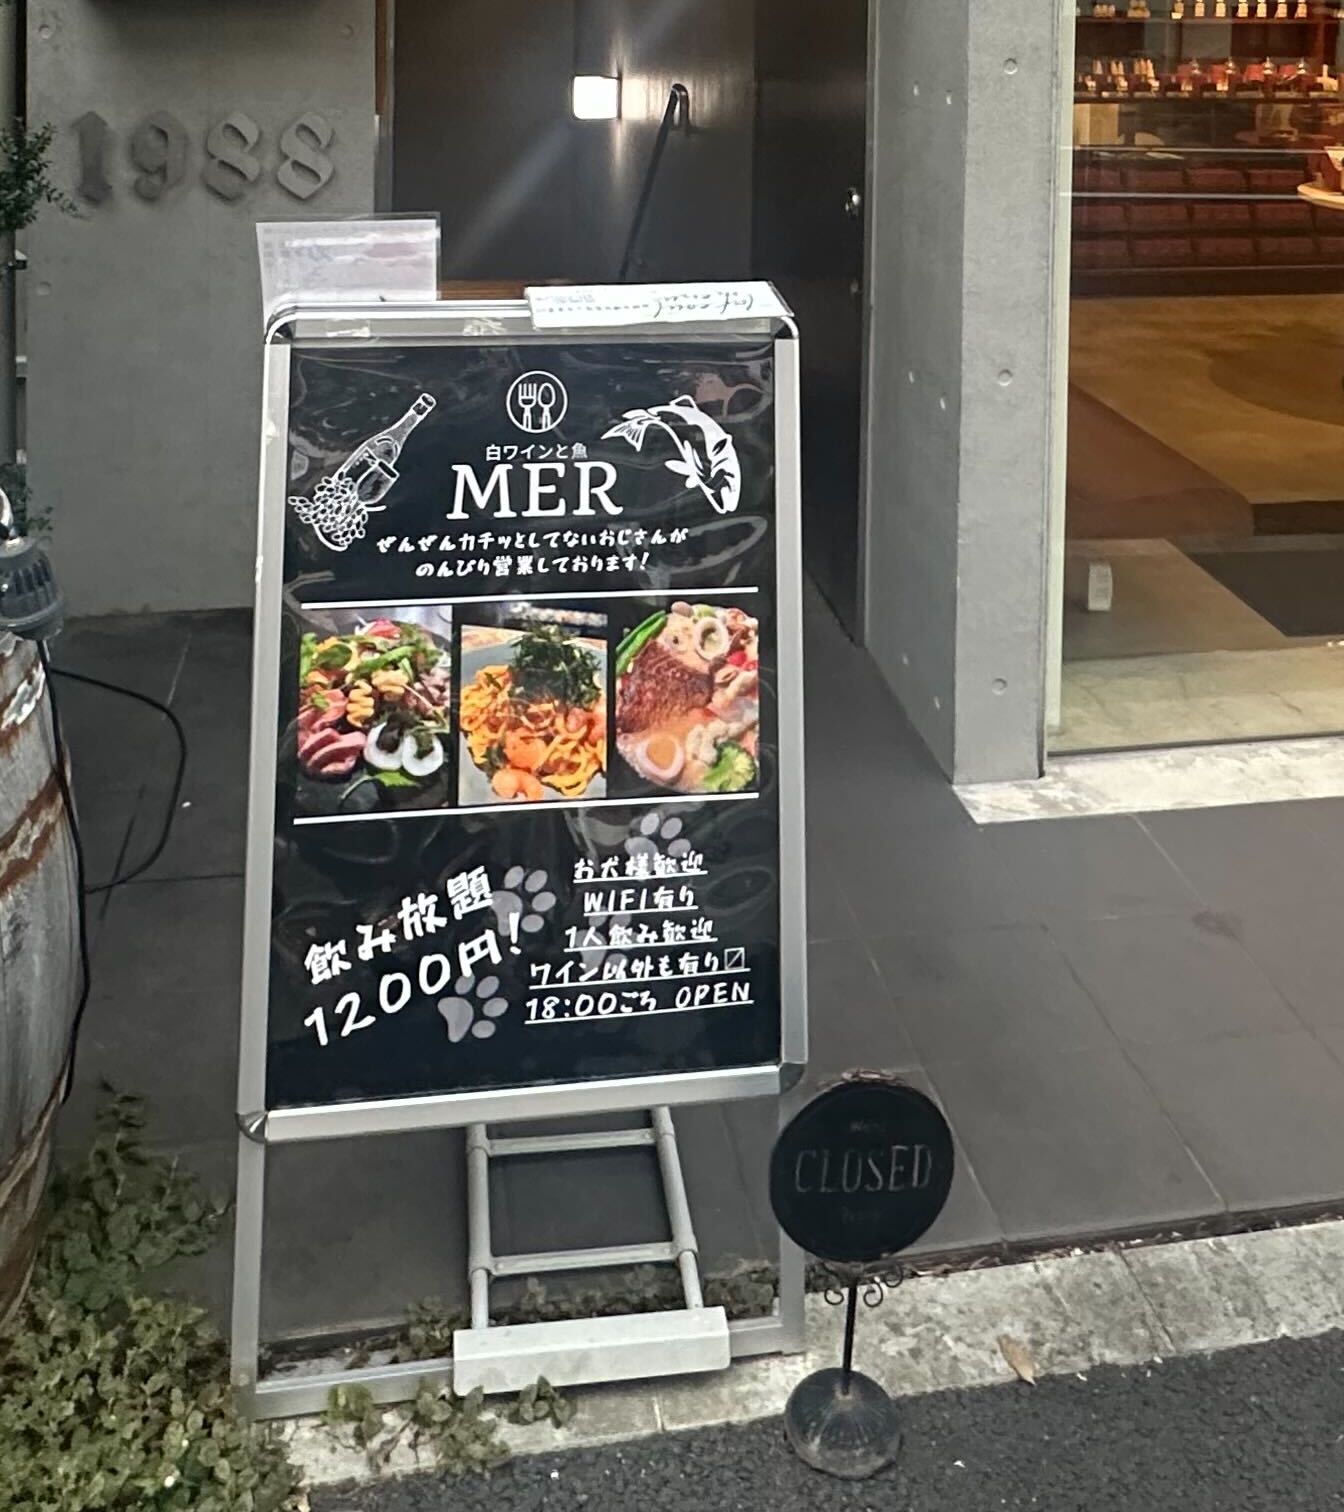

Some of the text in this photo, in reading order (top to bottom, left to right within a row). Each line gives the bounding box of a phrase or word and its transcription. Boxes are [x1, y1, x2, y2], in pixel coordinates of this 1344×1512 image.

[71, 110, 335, 202] 1988
[485, 442, 588, 461] 白ワインと魚
[446, 460, 623, 520] MER
[376, 528, 689, 553] ぜんぜんカチッとしてないおじさんが
[574, 850, 704, 880] お犬様歓迎
[304, 865, 494, 985] 飲み放題
[565, 917, 714, 948] 1人飲み歓迎
[304, 911, 522, 1047] 1200円!
[675, 982, 751, 1009] OPEN
[795, 1144, 933, 1193] CLOSED
